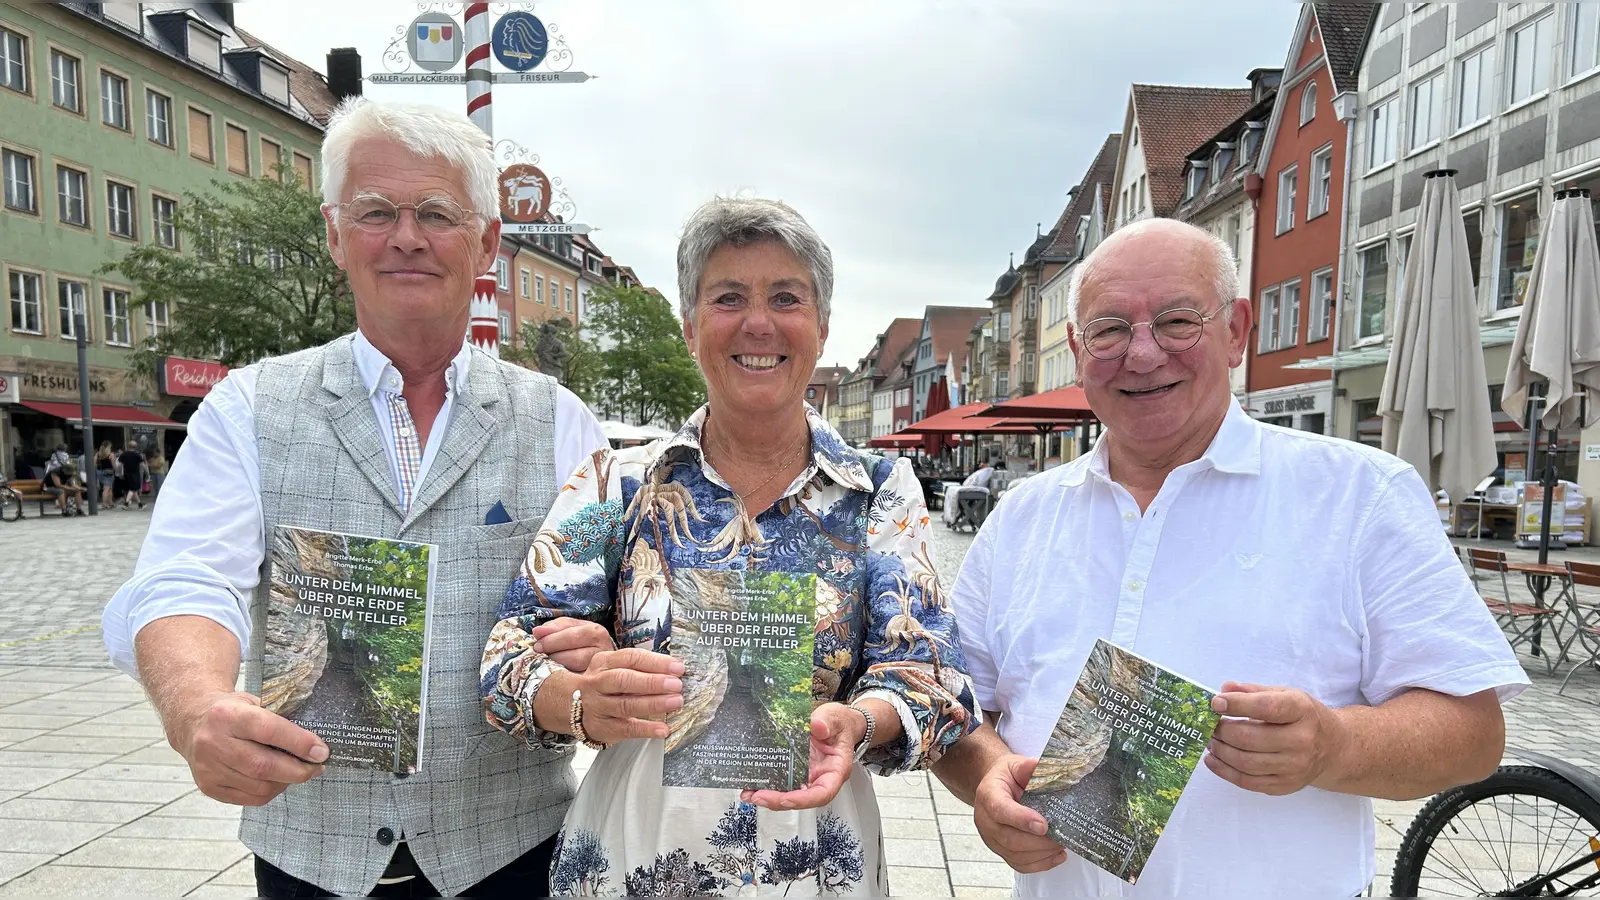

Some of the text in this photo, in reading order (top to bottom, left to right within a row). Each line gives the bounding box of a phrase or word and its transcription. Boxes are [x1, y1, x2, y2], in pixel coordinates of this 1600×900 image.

[520, 74, 560, 82] FRISEUR
[24, 375, 106, 392] FRESHLINS
[325, 552, 382, 565] Brigitte Merk-Erbe
[333, 561, 374, 572] Thomas Erbe
[286, 574, 422, 600] UNTER DEM HIMMEL
[746, 588, 776, 596] Merk-Erbe
[298, 587, 405, 612] ÜBER DER ERDE
[294, 604, 408, 626] AUF DEM TELLER
[687, 610, 810, 624] UNTER DEM HIMMEL
[701, 621, 796, 636] ÜBER DER ERDE
[696, 638, 799, 649] AUF DEM TELLER
[1139, 686, 1172, 704] Thomas Erbe
[1153, 684, 1182, 702] Merk-Erbe
[1092, 680, 1204, 742] UNTER DEM HIMMEL
[1098, 695, 1187, 747] ÜBER DER ERDE
[342, 732, 397, 742] LANDSCHAFTEN
[373, 727, 398, 735] DURCH
[1090, 707, 1184, 759] AUF DEM TELLER
[357, 740, 393, 749] BAYREUTH
[693, 744, 768, 753] GENUSSWANDERUNGEN
[1047, 801, 1132, 850] FASZINIERENDE LANDSCHAFTEN
[1050, 795, 1135, 844] GENUSSWANDERUNGEN DURCH
[1066, 817, 1088, 834] REGION
[1096, 837, 1126, 855] BAYREUTH
